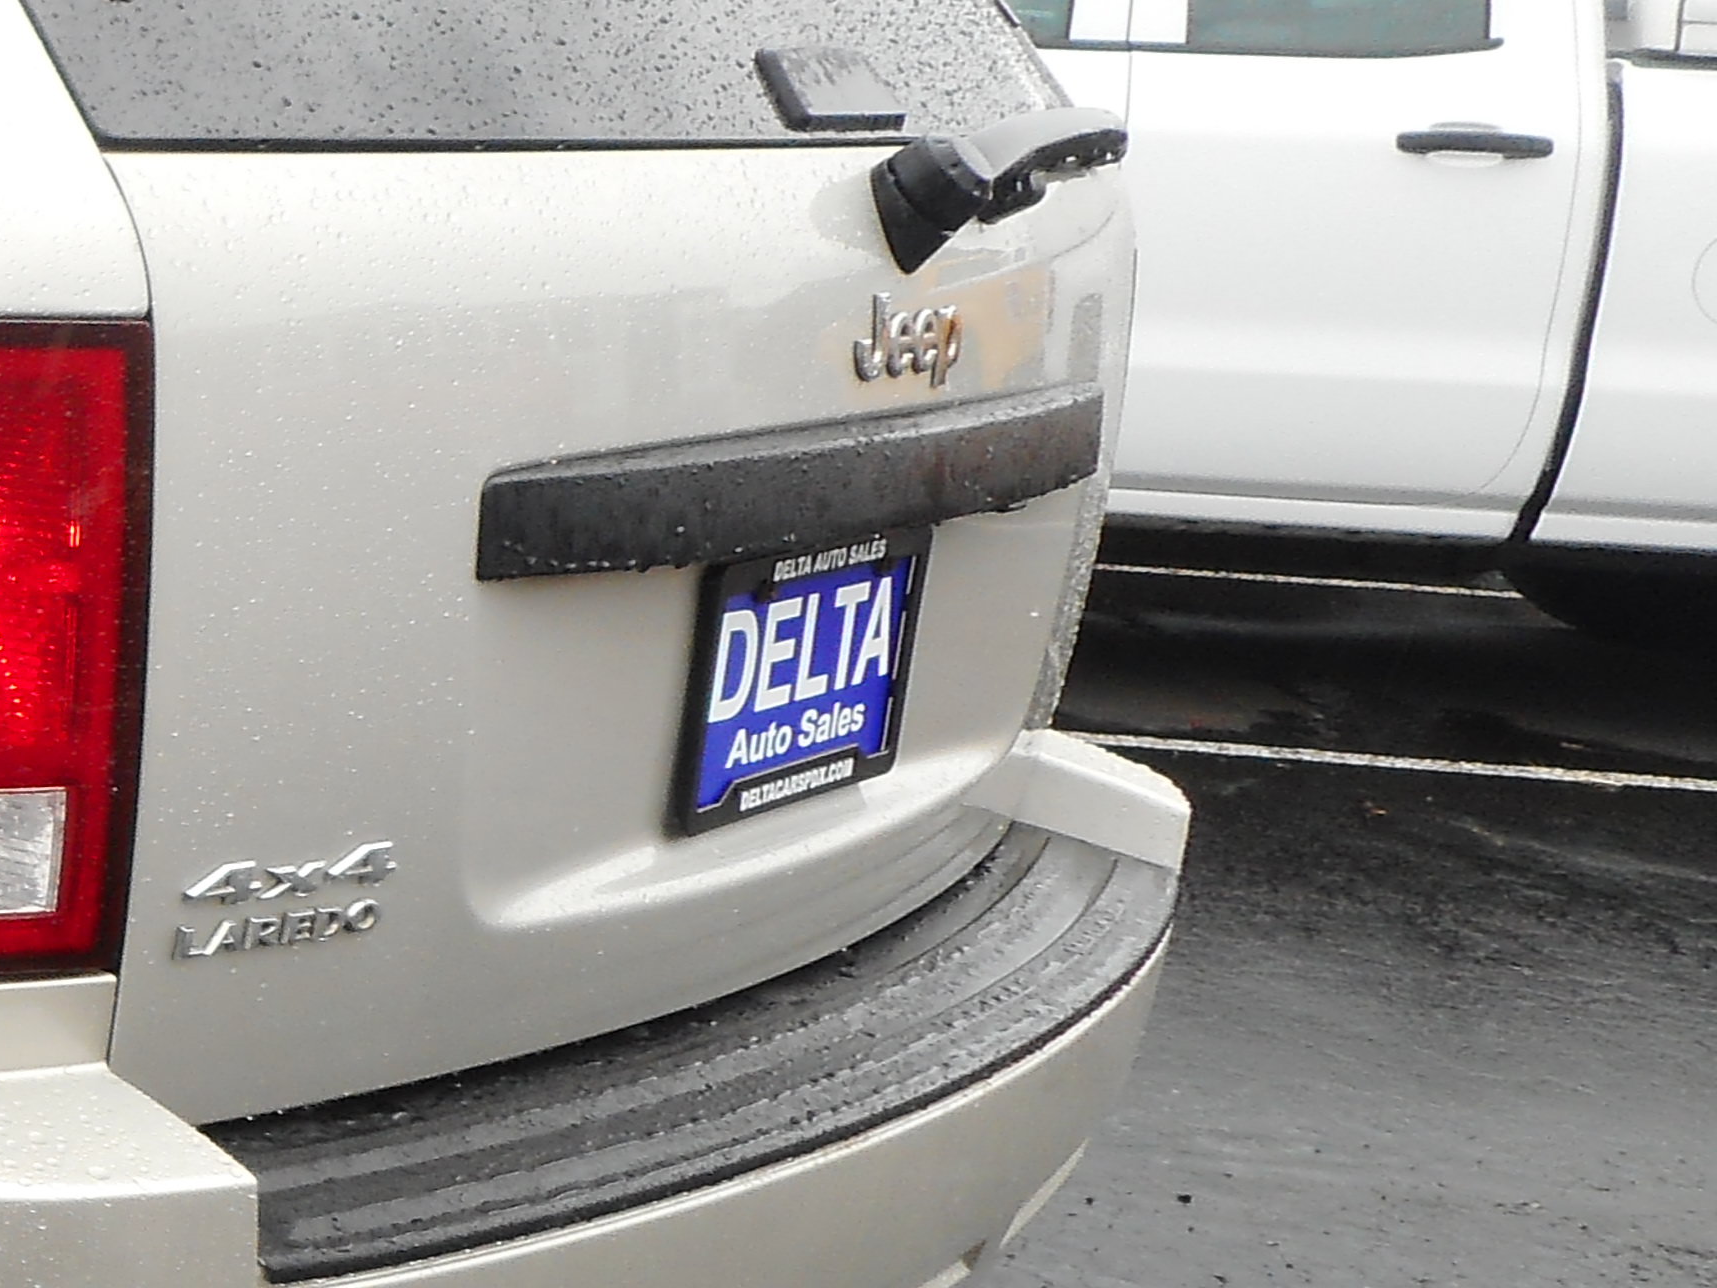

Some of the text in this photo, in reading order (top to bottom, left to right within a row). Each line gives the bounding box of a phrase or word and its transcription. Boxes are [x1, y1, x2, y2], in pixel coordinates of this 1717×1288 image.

[853, 291, 963, 389] Jeep
[772, 538, 888, 582] DELTA AUTO SALES
[707, 576, 893, 724] DELTA
[725, 702, 867, 769] Auto Sales
[182, 840, 397, 905] 4x4
[171, 897, 383, 960] LAREDO
